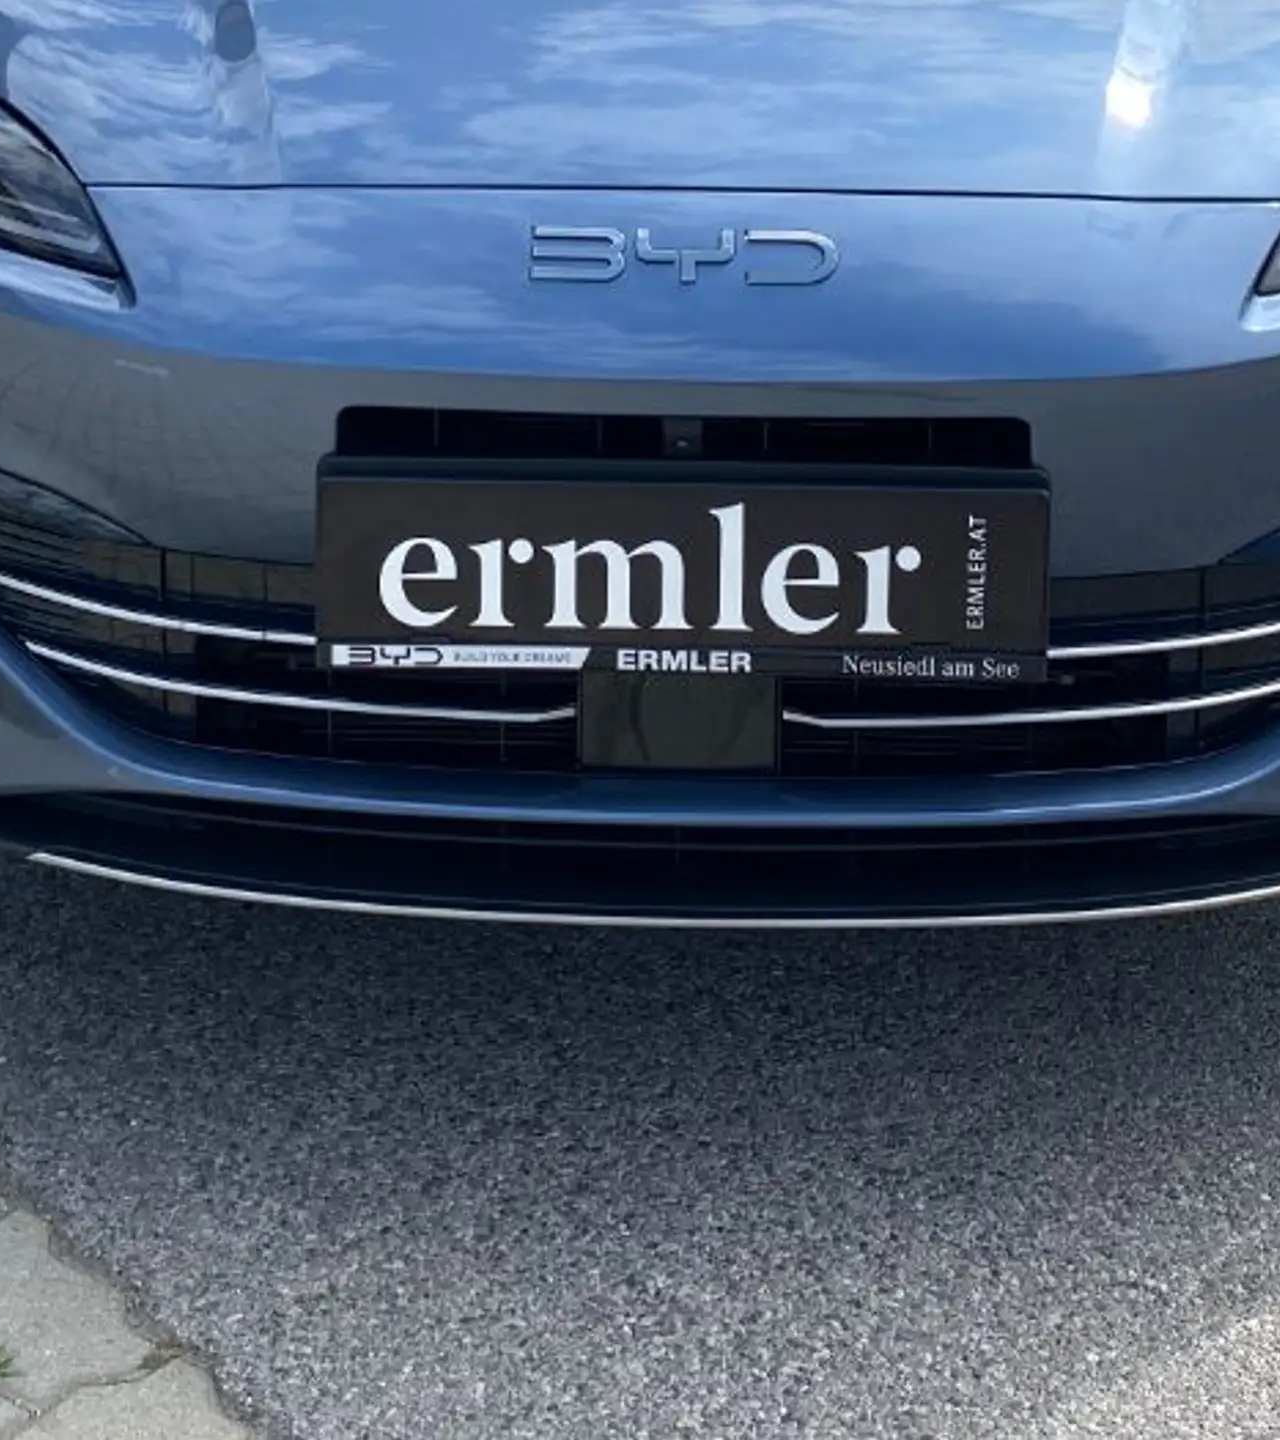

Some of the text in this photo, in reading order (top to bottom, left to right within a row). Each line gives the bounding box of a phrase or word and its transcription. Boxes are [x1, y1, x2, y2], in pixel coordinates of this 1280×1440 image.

[529, 225, 838, 285] BYD
[379, 502, 921, 634] ermler
[966, 514, 987, 630] ERMLER.AT
[347, 647, 443, 666] BYD
[617, 649, 751, 673] ERMLER
[842, 655, 1020, 679] Neusiedl am See
